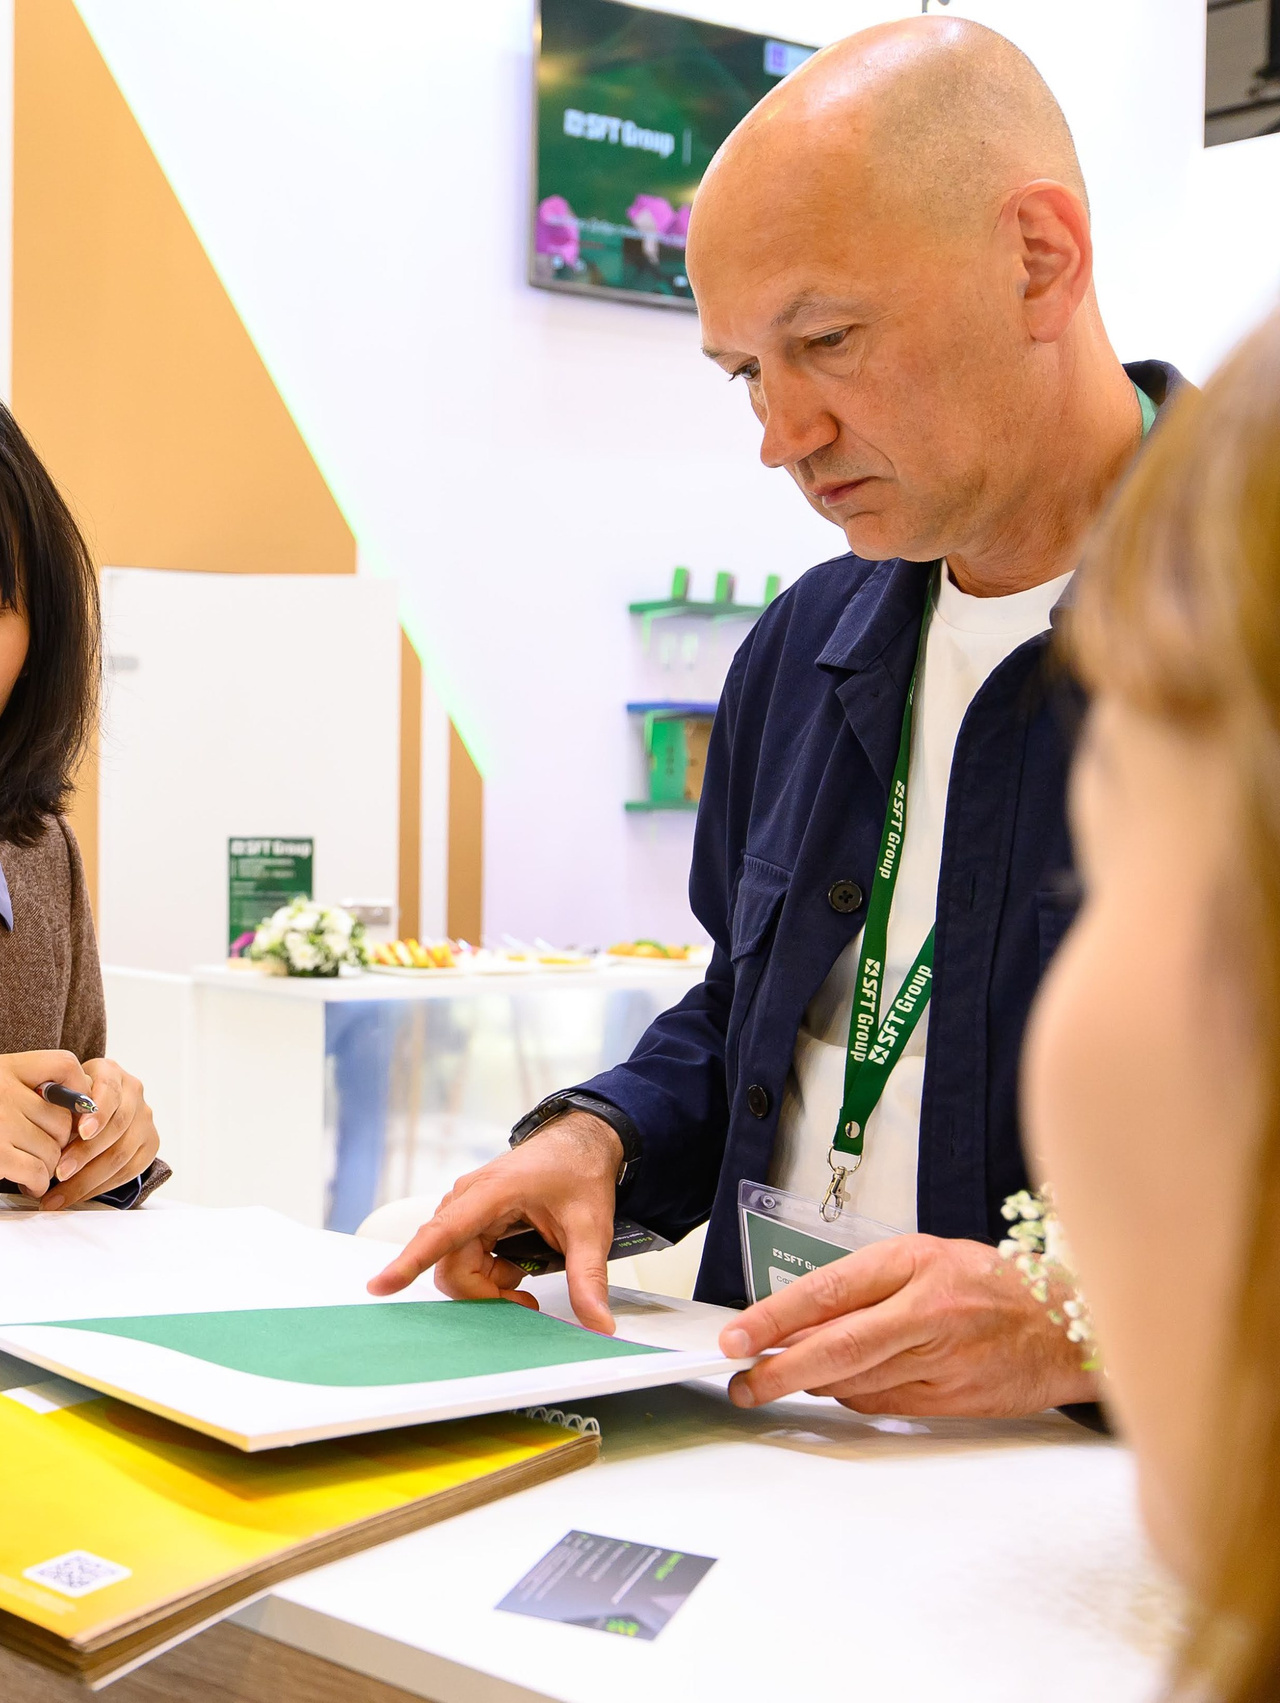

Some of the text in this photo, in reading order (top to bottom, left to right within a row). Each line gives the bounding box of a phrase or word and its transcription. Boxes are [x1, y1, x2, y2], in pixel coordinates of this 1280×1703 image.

[585, 111, 675, 159] SFT Group
[880, 800, 905, 879] SFT Group
[850, 976, 880, 1063] SFT Group
[878, 964, 933, 1048] SFT Group
[784, 1252, 804, 1267] SFT
